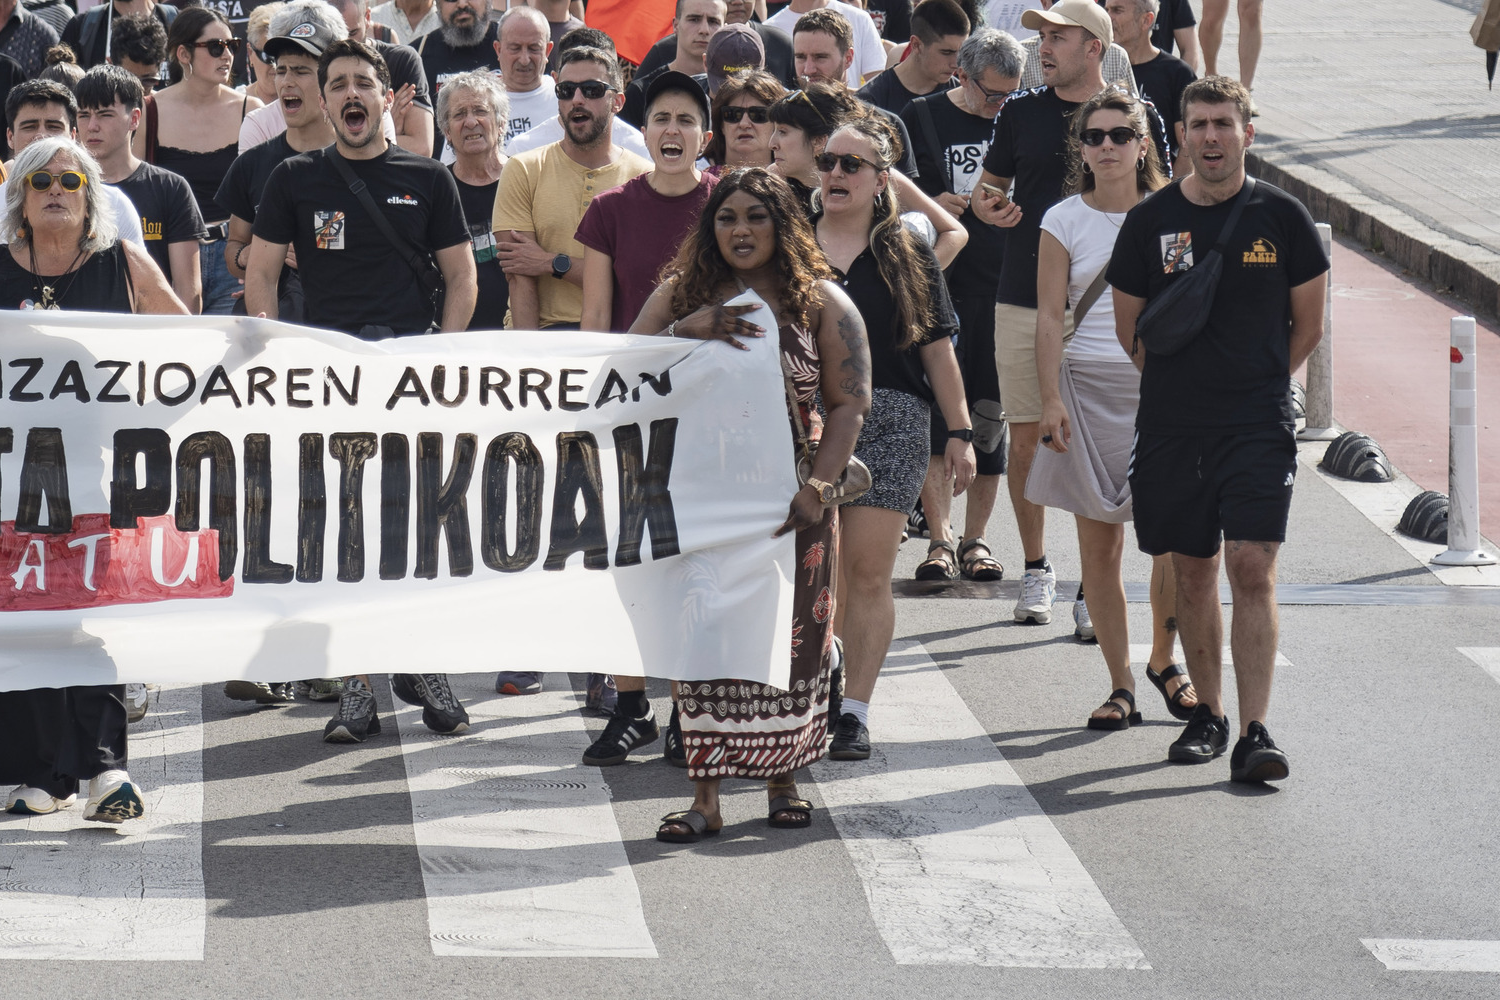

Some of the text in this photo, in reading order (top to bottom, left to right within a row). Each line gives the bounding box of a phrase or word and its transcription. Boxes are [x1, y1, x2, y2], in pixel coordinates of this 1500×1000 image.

[386, 196, 418, 206] ellesse
[385, 364, 674, 412] AURREAN
[109, 417, 681, 584] POLITIKOAK
